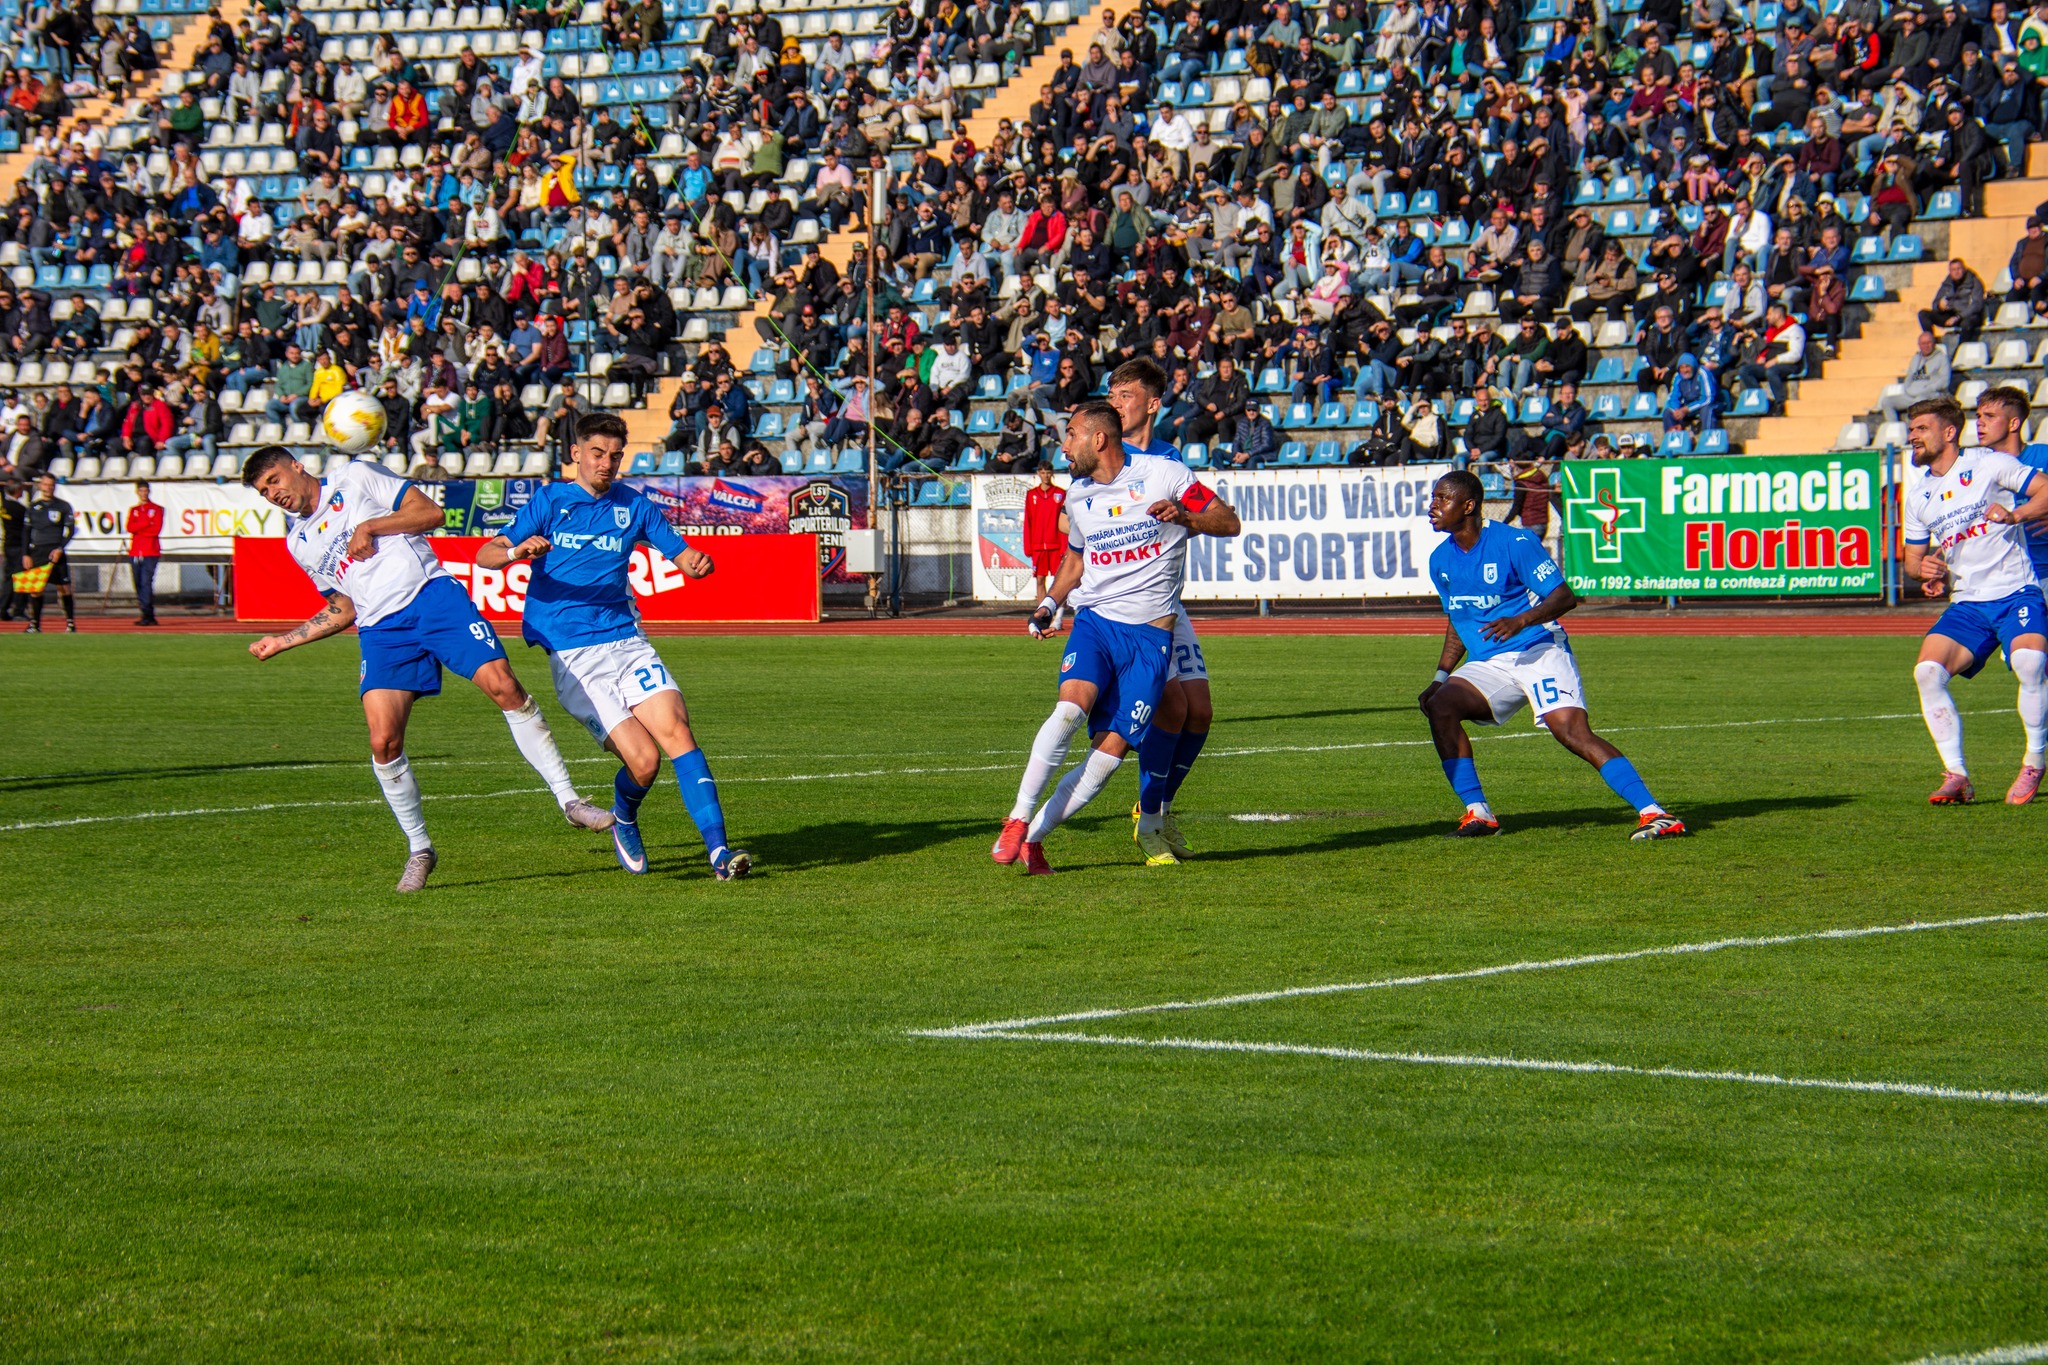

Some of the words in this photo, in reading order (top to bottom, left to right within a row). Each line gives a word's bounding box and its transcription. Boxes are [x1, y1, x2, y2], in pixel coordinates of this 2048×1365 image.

[1217, 478, 1327, 521] ÂMNICU
[1341, 475, 1435, 519] VÂLCE
[1661, 462, 1870, 515] Farmacia
[181, 509, 272, 535] STICKY
[808, 506, 831, 516] LIGA
[1090, 541, 1162, 566] ROTAKT
[1243, 529, 1419, 582] SPORTUL
[1684, 519, 1871, 571] Florina
[1600, 576, 1631, 590] 1992
[1704, 576, 1718, 589] ta
[1721, 574, 1785, 589] contează
[1788, 575, 1837, 591] pentru
[2018, 606, 2029, 617] 9
[469, 621, 491, 641] 97
[634, 663, 668, 692] 27
[1533, 677, 1559, 709] 15
[1131, 700, 1152, 724] 30
